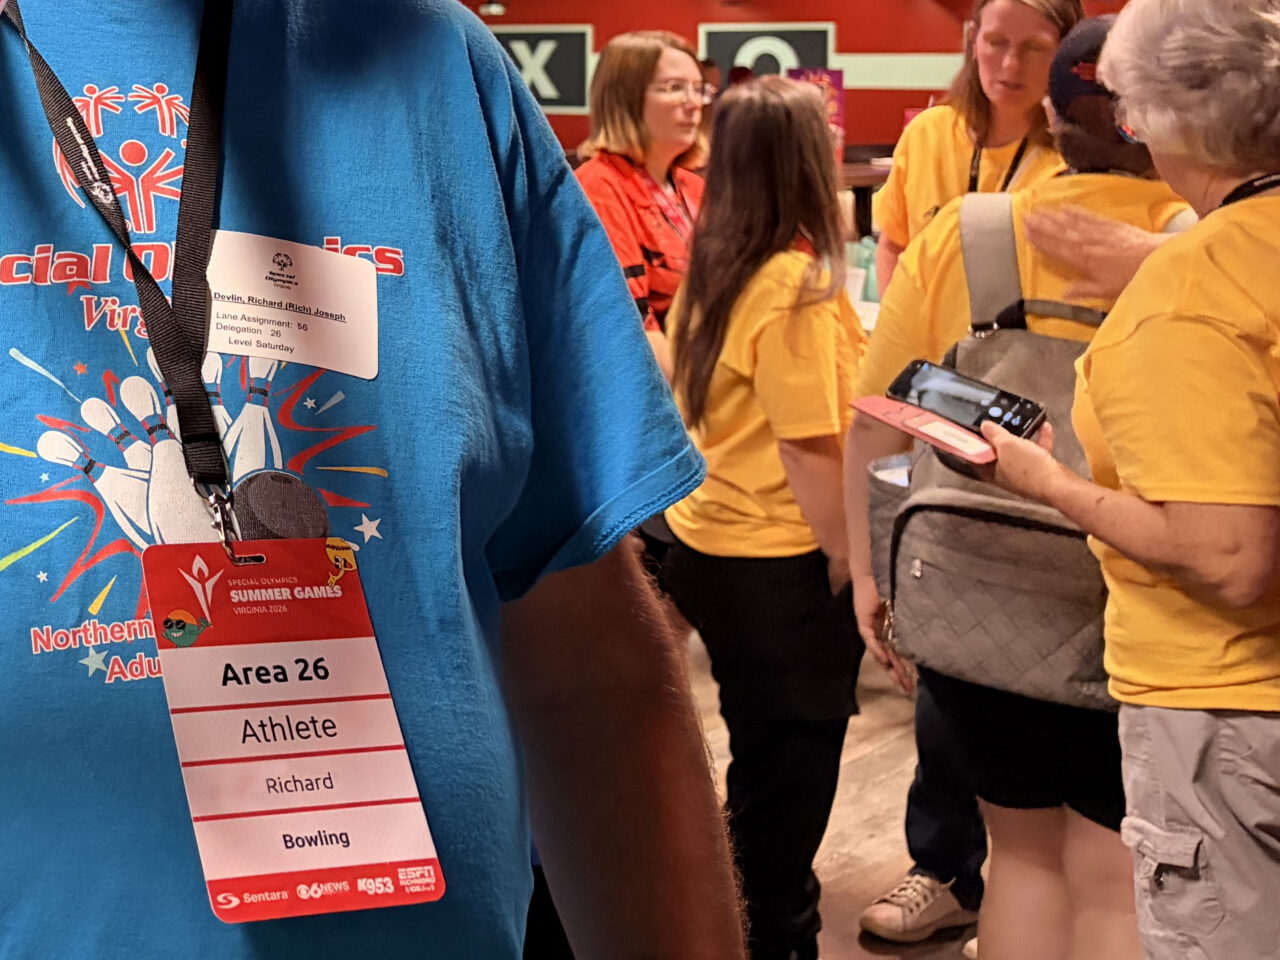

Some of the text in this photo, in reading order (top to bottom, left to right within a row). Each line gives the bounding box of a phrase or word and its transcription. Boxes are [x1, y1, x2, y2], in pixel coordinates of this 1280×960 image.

[510, 40, 559, 99] X
[216, 311, 238, 321] Lane
[240, 313, 293, 329] Assignment:
[247, 295, 283, 308] Richard
[284, 302, 312, 315] (Rich)
[313, 308, 347, 322] Joseph
[215, 322, 282, 338] Delegation 26
[228, 337, 295, 354] Level Saturday
[227, 576, 298, 587] SPECIAL OLYMPICS
[230, 585, 343, 603] SUMMER GAMES
[233, 605, 268, 616] VIRGINIA
[31, 619, 156, 655] Northern
[105, 652, 163, 684] Adu
[222, 657, 330, 687] Area 26
[241, 714, 338, 745] Athlete
[265, 772, 335, 795] Richard
[282, 829, 351, 851] Bowling
[243, 890, 289, 904] Sentara
[397, 865, 436, 880] ESPN
